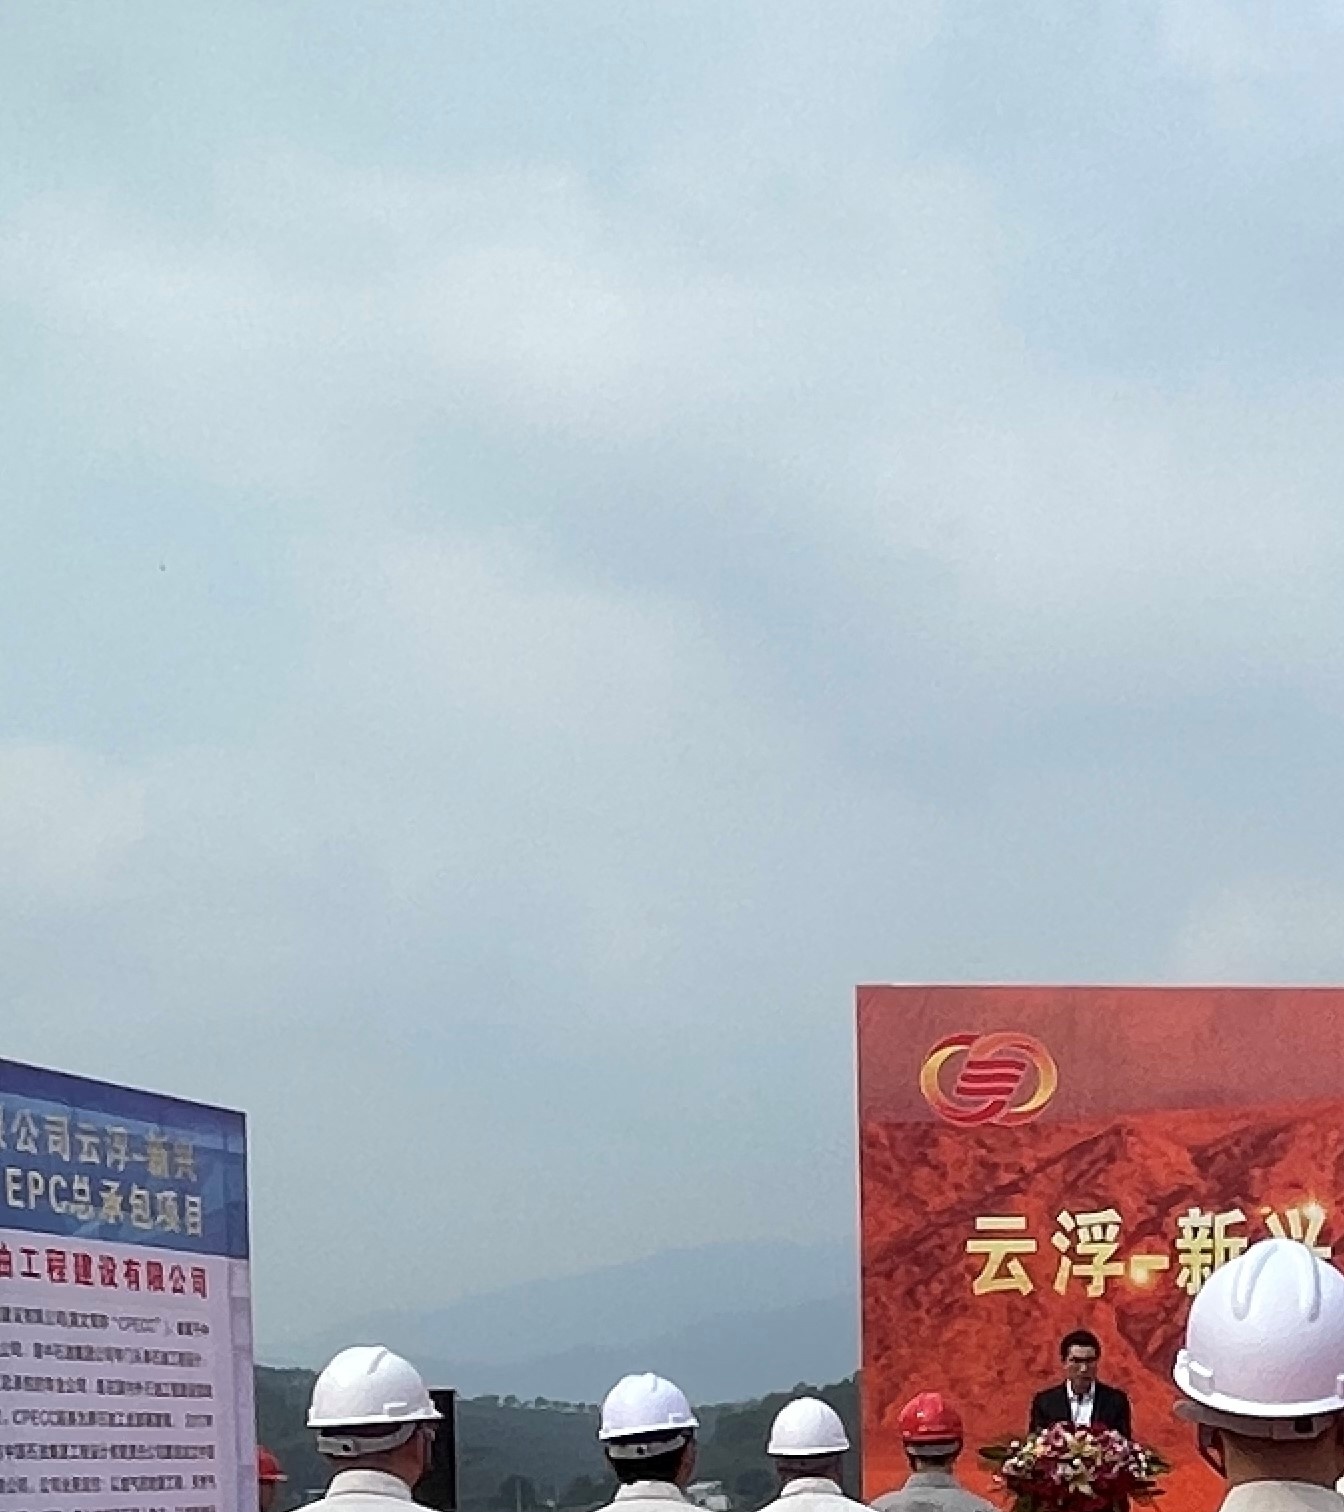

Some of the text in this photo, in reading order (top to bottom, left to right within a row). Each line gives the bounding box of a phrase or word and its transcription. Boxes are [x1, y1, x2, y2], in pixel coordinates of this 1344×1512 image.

[0, 1103, 198, 1182] 公司云浮-新兴
[6, 1167, 201, 1237] EPC总承包项目
